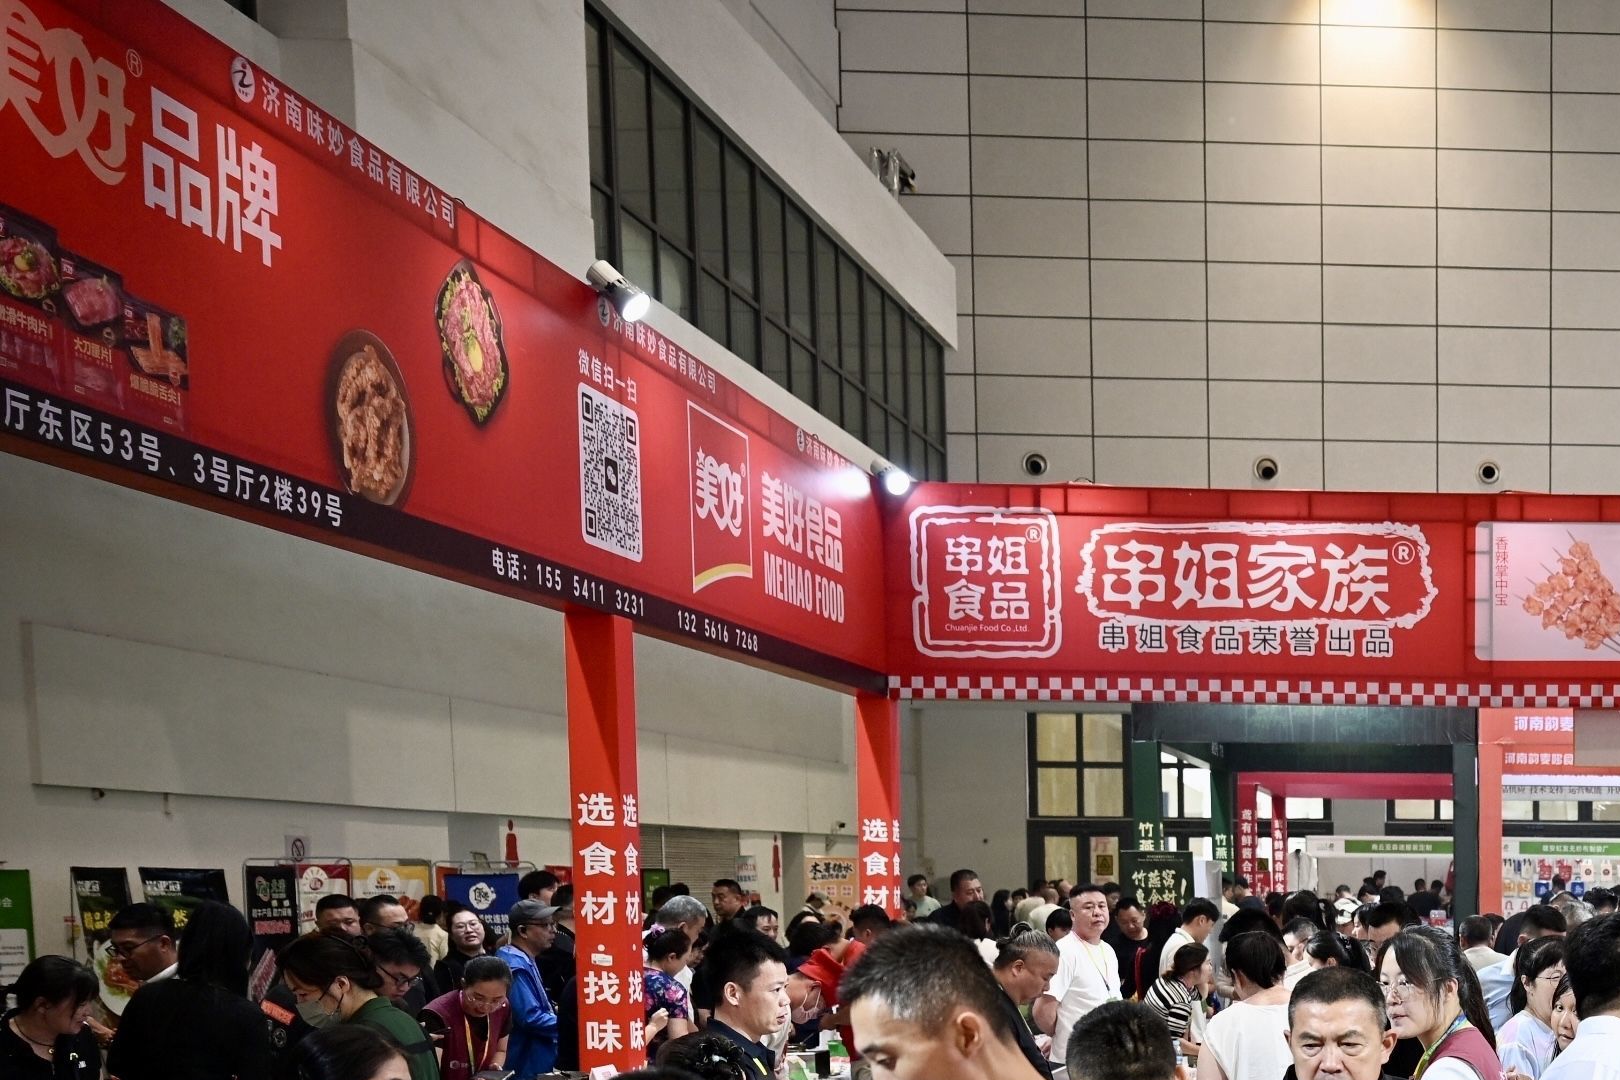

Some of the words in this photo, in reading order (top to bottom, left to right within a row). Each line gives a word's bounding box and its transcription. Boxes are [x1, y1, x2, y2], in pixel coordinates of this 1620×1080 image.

[142, 87, 282, 268] 品牌
[262, 80, 456, 229] 济南味妙食品有限公司
[578, 348, 638, 405] 微信扫一扫
[612, 312, 716, 395] 济南味妙食品有限公司
[762, 472, 844, 574] 美好食品
[945, 535, 1030, 577] 串姐
[537, 563, 562, 590] 155
[573, 575, 605, 605] 5411
[615, 591, 645, 617] 3231
[677, 609, 697, 634] 132
[705, 618, 729, 644] 5616
[736, 628, 759, 652] 7268
[764, 550, 813, 612] MEIHAO
[815, 575, 846, 624] FOOD
[944, 579, 1030, 622] 食品
[1102, 539, 1391, 614] 串姐家族
[1495, 536, 1509, 607] 香辣掌中宝
[945, 624, 978, 635] Chuanjie
[980, 624, 999, 633] Food
[1103, 624, 1392, 655] 串姐食品荣誉出品
